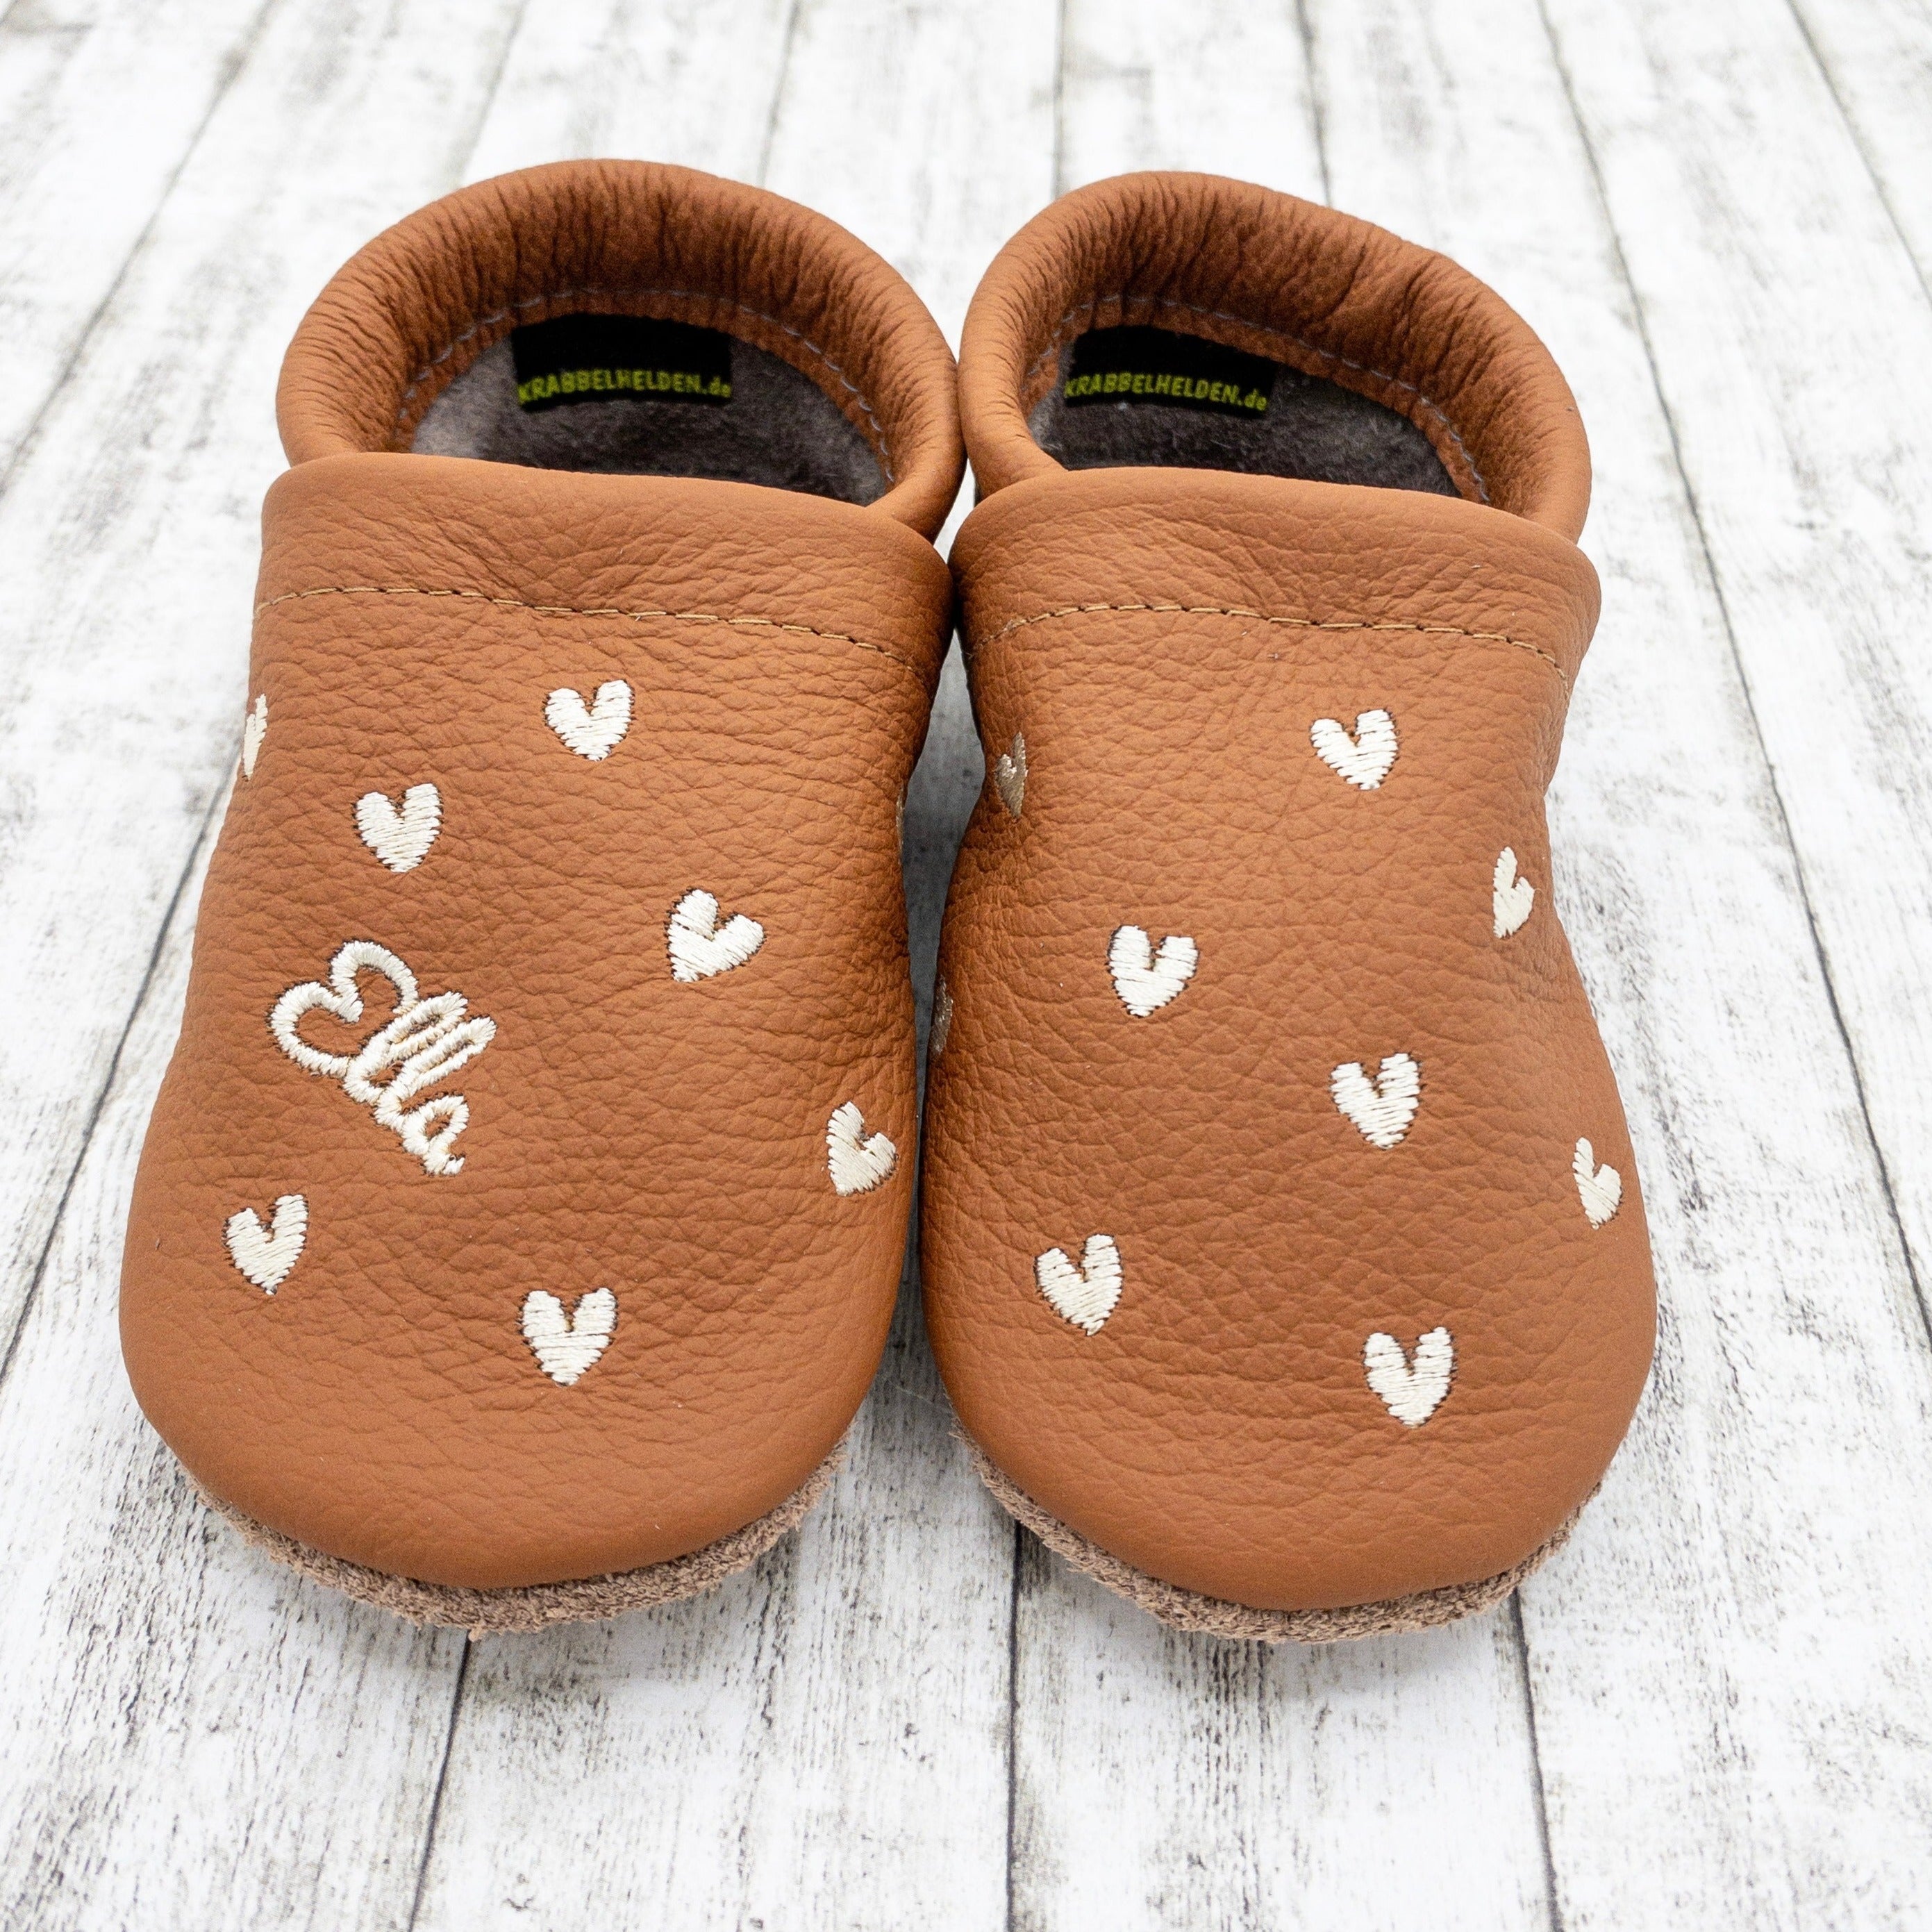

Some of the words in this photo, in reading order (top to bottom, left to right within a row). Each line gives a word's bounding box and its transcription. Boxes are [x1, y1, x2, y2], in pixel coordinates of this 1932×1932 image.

[517, 369, 730, 403] KRABBELHELDEN.de
[1064, 372, 1267, 411] KRABBELHELDEN.de
[269, 940, 497, 1175] Ella
